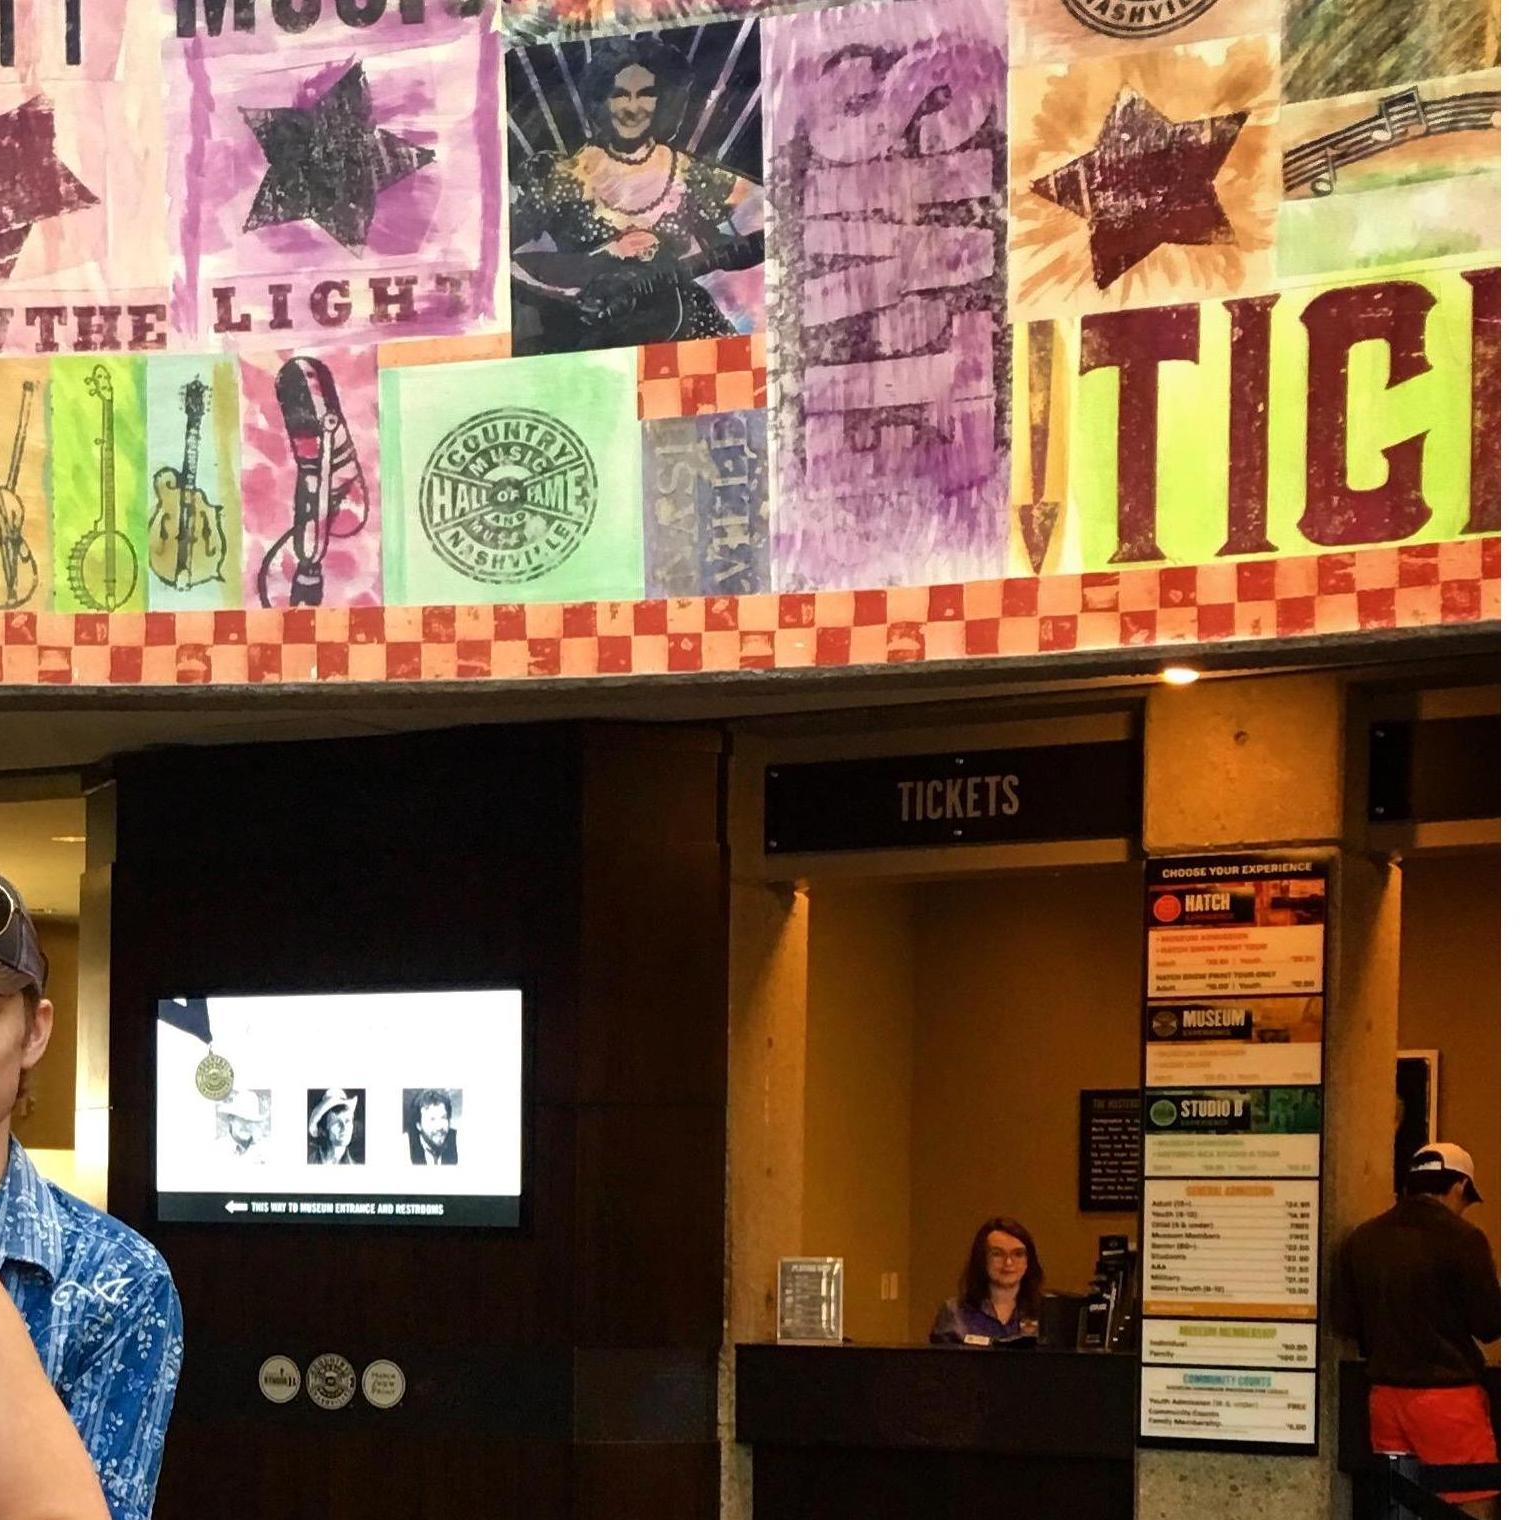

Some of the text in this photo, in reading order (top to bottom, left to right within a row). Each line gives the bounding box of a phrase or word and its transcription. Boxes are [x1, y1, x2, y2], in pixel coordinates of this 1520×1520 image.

[25, 303, 168, 353] THE
[447, 421, 572, 467] COUNTRY
[469, 446, 547, 476] MUSIC
[431, 467, 586, 523] HALL OF FAME
[492, 513, 527, 525] AND
[897, 774, 1020, 822] TICKETS
[1162, 862, 1313, 879] CHOOSE YOUR EXPERIENCE
[1185, 893, 1230, 913] HATCH
[1183, 1008, 1246, 1028] MUSEUM
[1181, 1099, 1230, 1118] STUDIO
[251, 1201, 445, 1215] THIS WAY TO MUSEUM ENTRANCE AND RESTROOMS
